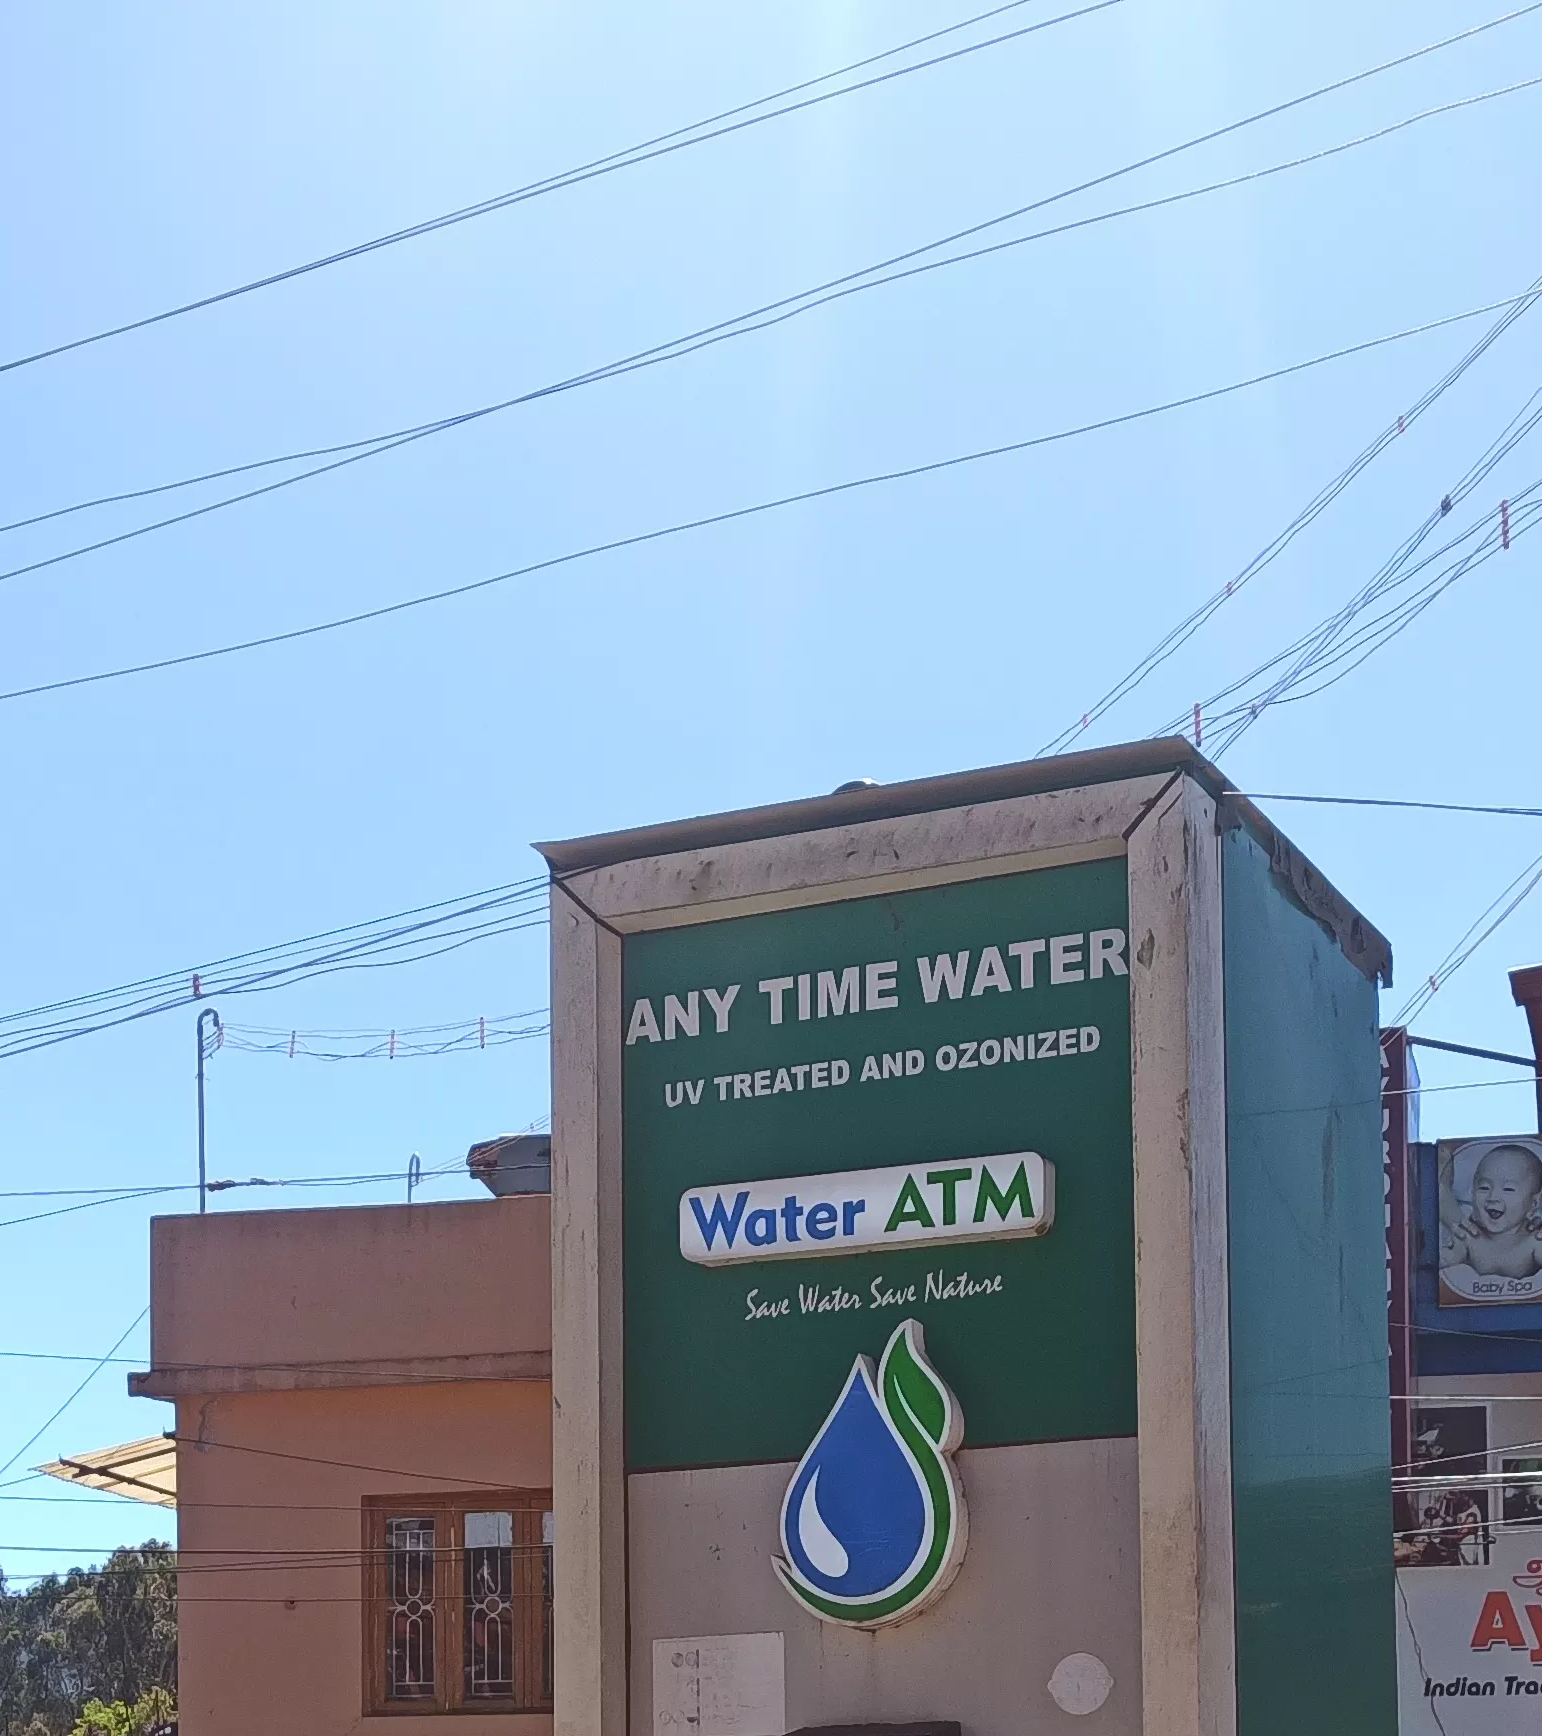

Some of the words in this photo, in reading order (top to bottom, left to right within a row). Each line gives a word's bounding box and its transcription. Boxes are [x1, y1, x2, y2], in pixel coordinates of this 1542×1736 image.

[625, 984, 741, 1046] ANY
[758, 960, 899, 1026] TIME
[917, 927, 1129, 1004] WATER
[664, 1079, 706, 1108] UV
[713, 1059, 850, 1103] TREATED
[859, 1049, 925, 1083] AND
[935, 1025, 1101, 1072] OZONIZED
[688, 1190, 866, 1251] Water
[883, 1160, 1035, 1234] ATM
[744, 1290, 790, 1322] Save
[799, 1282, 863, 1315] Water
[870, 1276, 918, 1308] Save
[925, 1269, 1004, 1304] Nature
[1472, 1281, 1504, 1295] Baby
[1506, 1280, 1533, 1293] Spa
[1423, 1677, 1496, 1698] Indian
